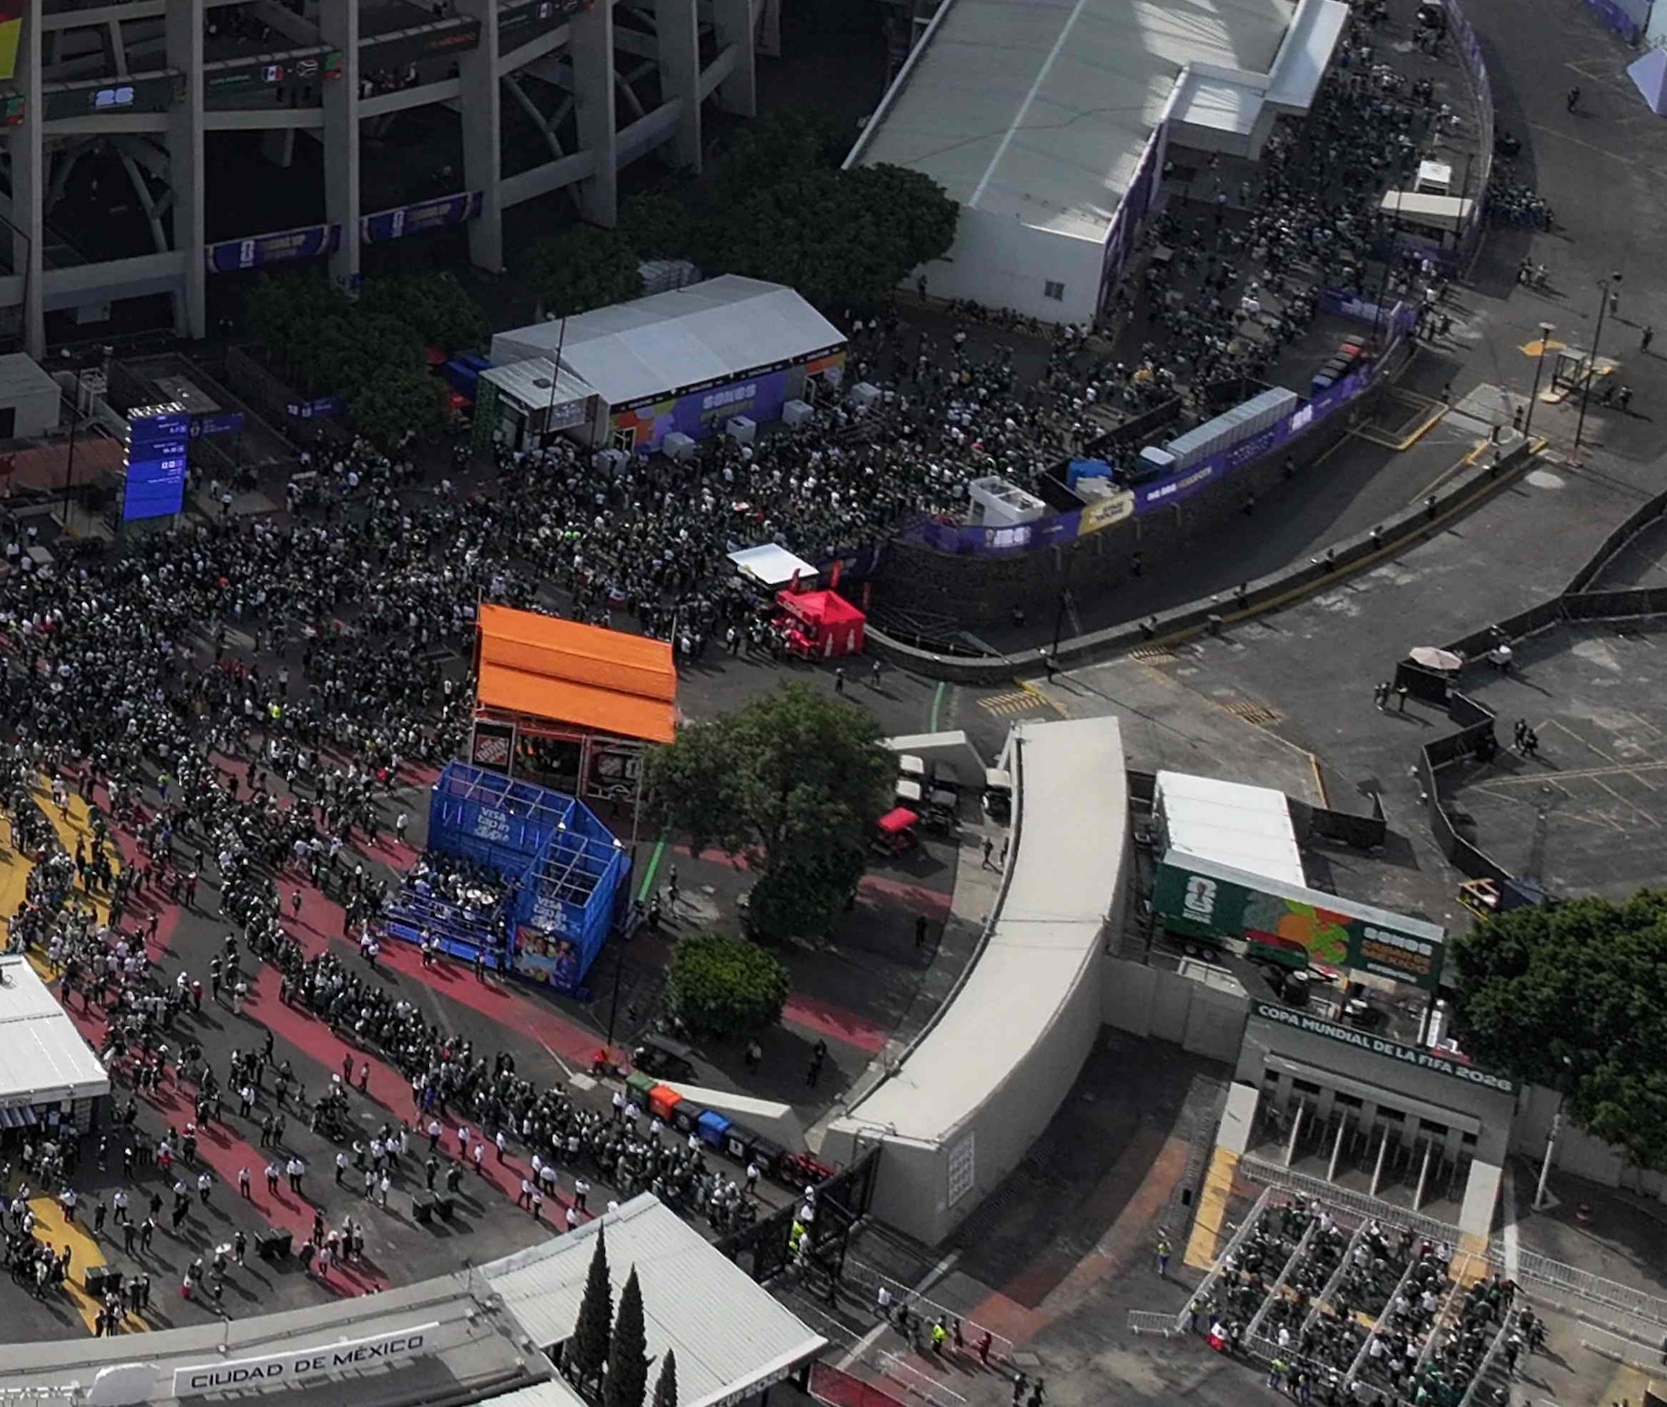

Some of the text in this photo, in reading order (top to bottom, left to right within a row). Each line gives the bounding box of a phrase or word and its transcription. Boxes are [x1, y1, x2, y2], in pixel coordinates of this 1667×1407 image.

[1257, 1004, 1514, 1092] COPA MUNDIAL DE LA FIFA 2026
[190, 1334, 424, 1390] CIUDAD DE MÉXICO
